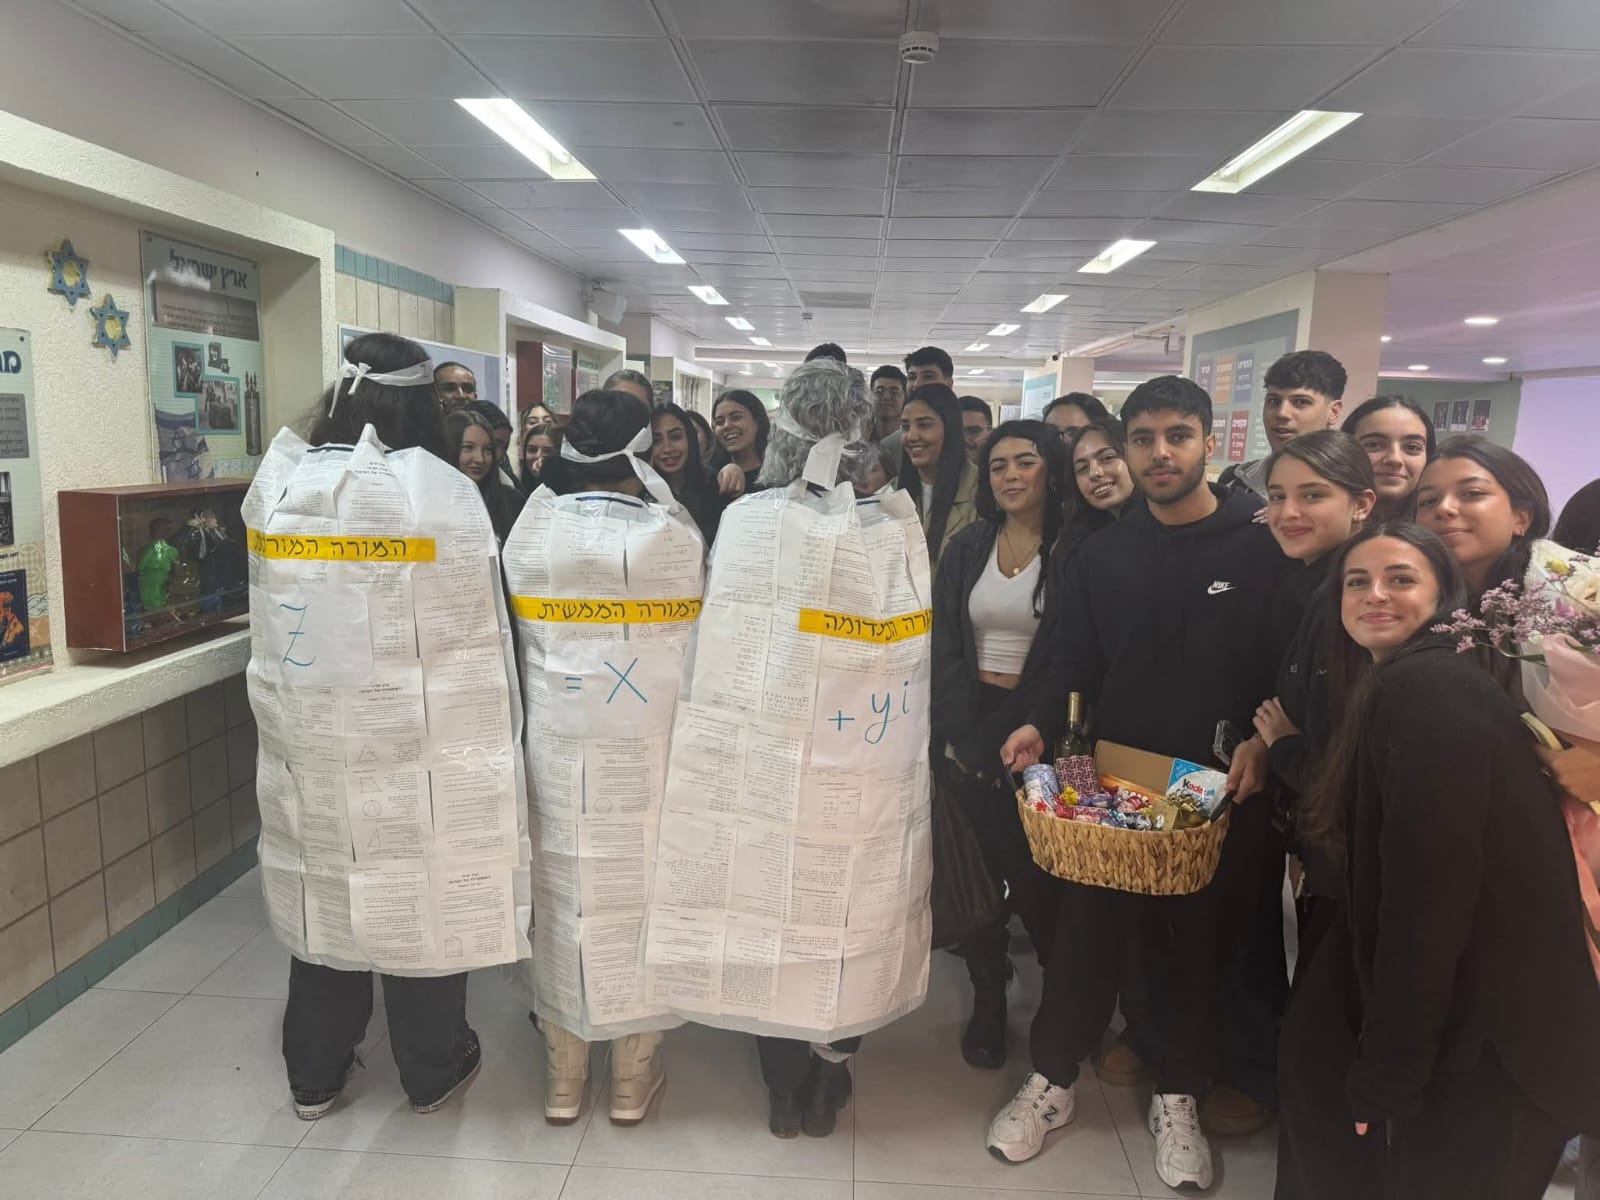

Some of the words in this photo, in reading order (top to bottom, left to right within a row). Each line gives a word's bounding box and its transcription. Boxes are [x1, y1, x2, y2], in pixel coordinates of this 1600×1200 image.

[220, 266, 248, 290] ארץ
[330, 538, 408, 558] המורה
[537, 601, 626, 620] הממשית
